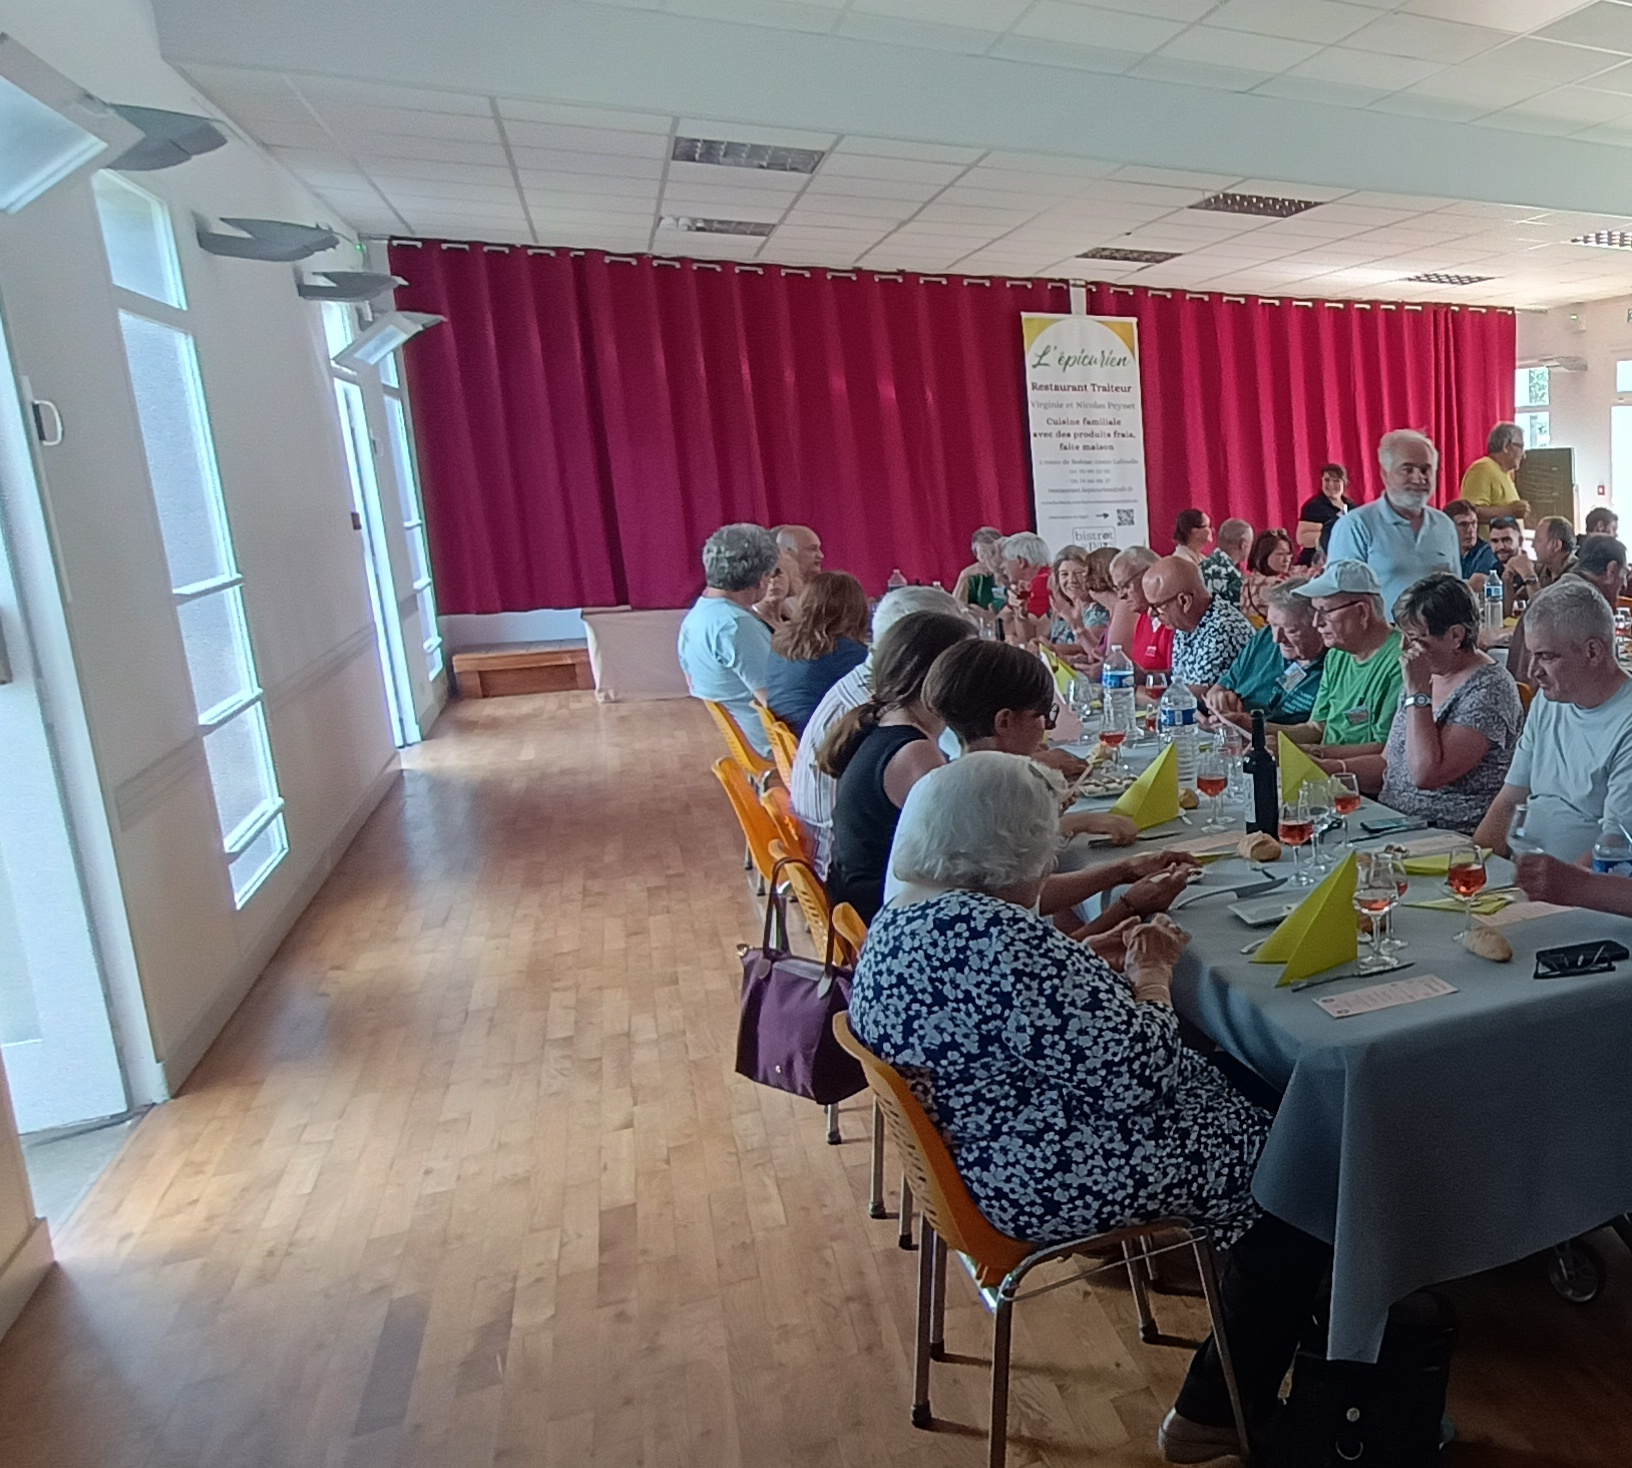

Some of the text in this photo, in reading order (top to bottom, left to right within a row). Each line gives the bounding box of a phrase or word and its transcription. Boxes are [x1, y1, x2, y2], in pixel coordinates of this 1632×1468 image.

[1031, 382, 1132, 393] Restaurant Traiteur
[1031, 401, 1064, 410] Virginie
[1076, 401, 1106, 409] Nicolas
[1046, 417, 1121, 426] Cuisine familiale
[1056, 430, 1071, 438] des
[1073, 430, 1111, 440] produits
[1059, 443, 1114, 451] faite maison
[1075, 531, 1114, 541] bistrot
